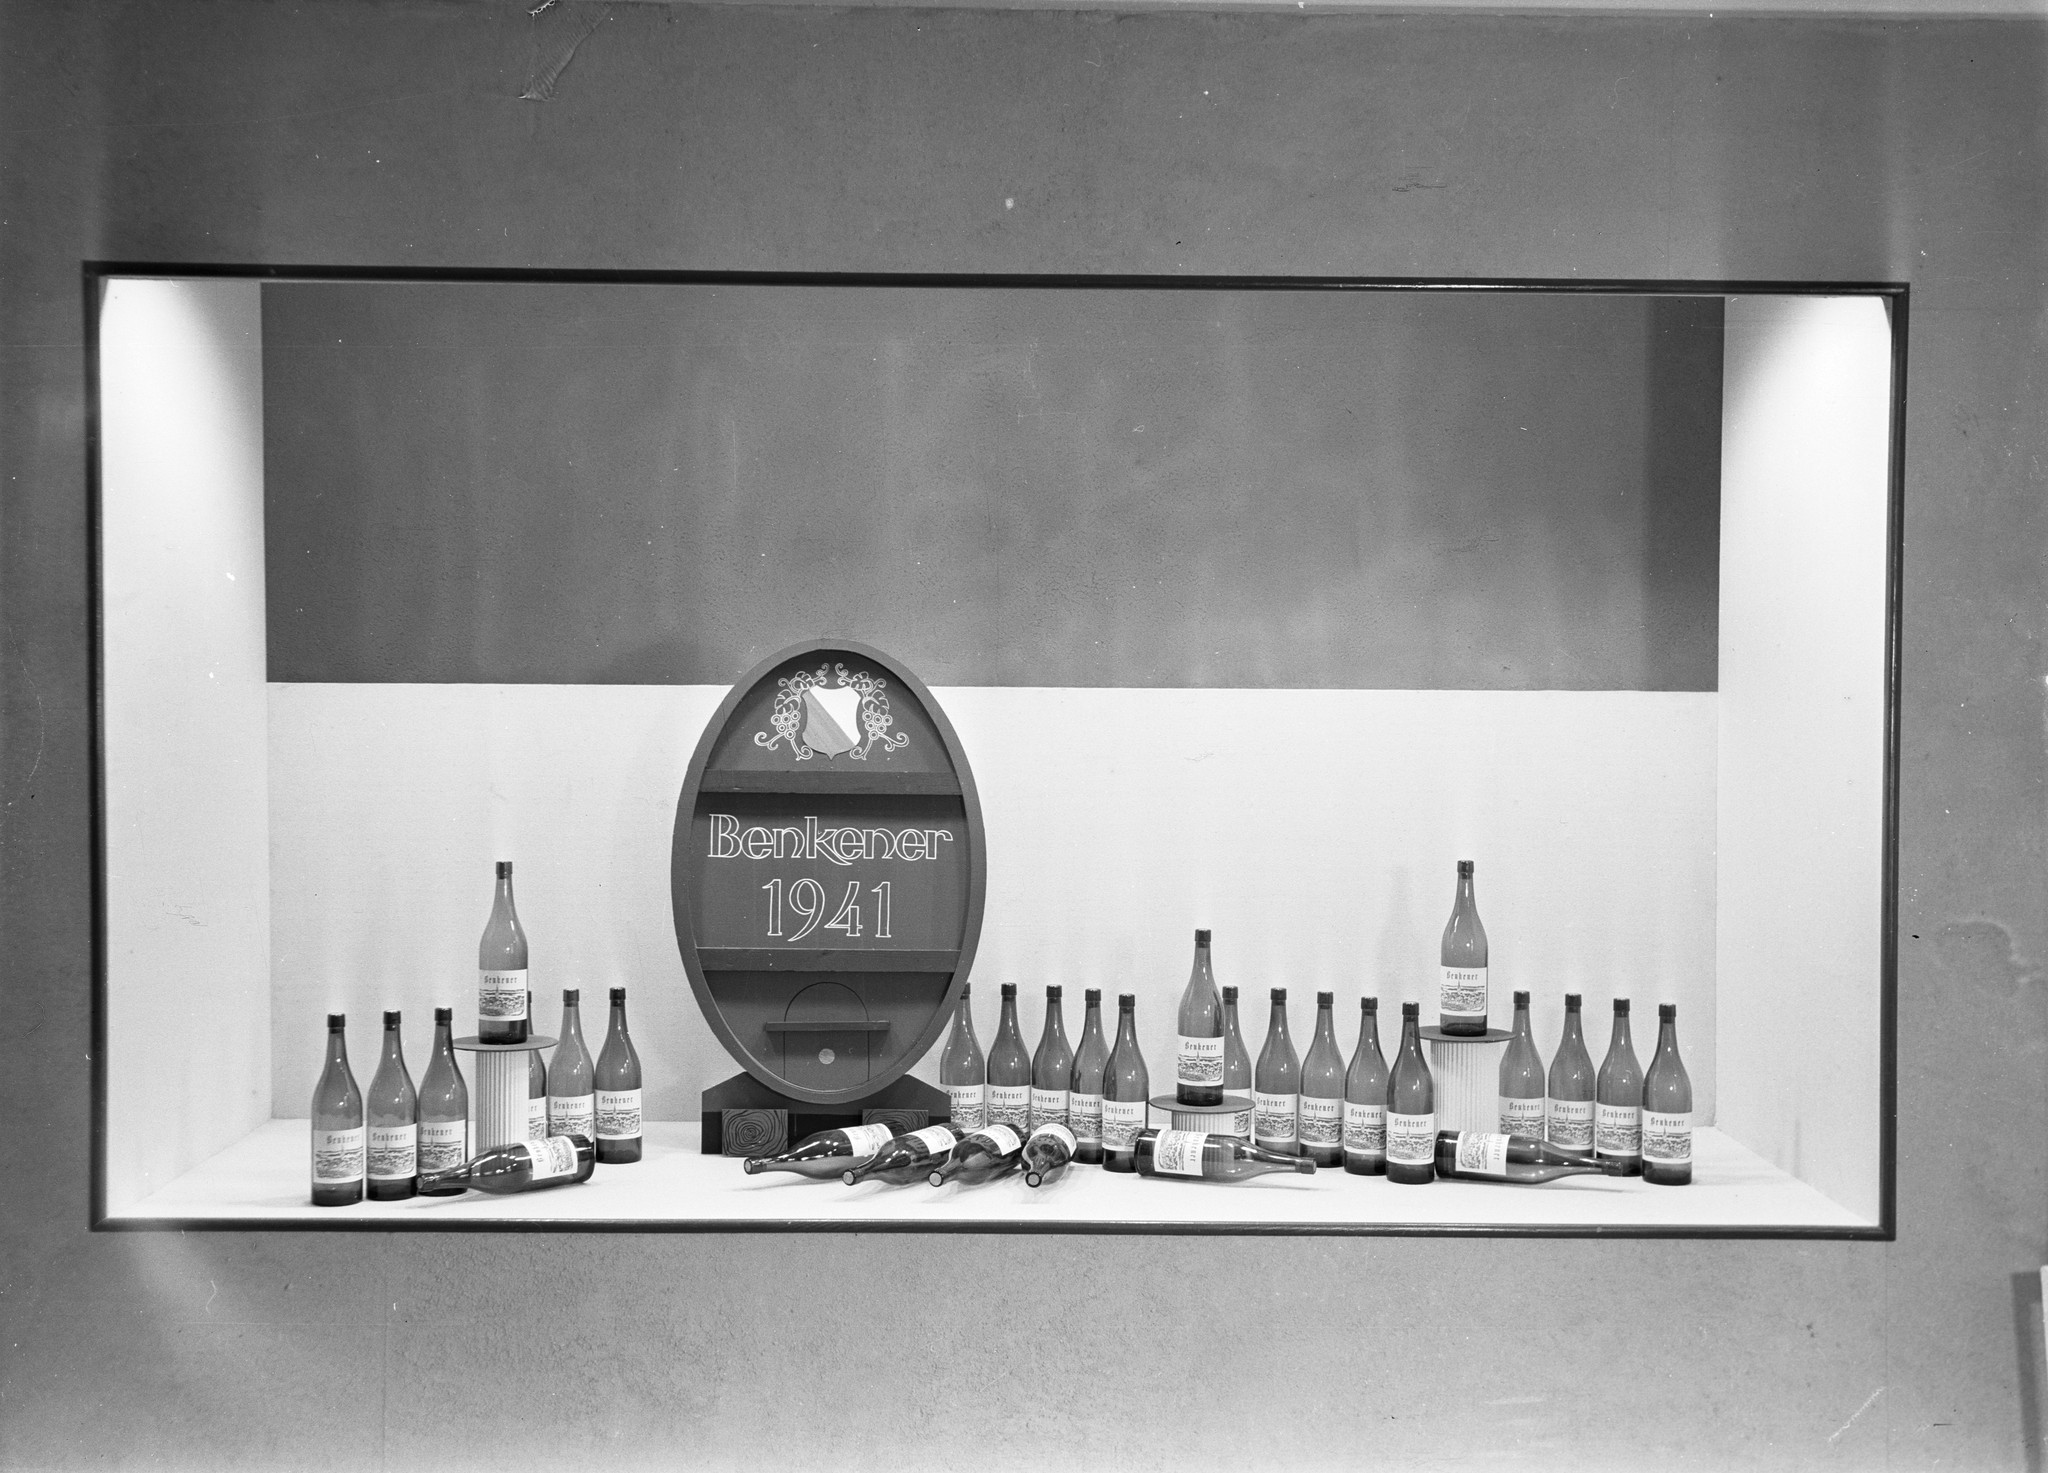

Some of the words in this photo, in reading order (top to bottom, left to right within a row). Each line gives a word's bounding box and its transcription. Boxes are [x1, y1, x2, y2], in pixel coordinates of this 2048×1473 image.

[708, 814, 953, 865] Benkener
[762, 878, 891, 941] 1941
[484, 975, 518, 984] Benkener
[1446, 971, 1478, 981] Benkener
[1185, 1041, 1217, 1051] Benkener
[601, 1095, 633, 1104] Benkener
